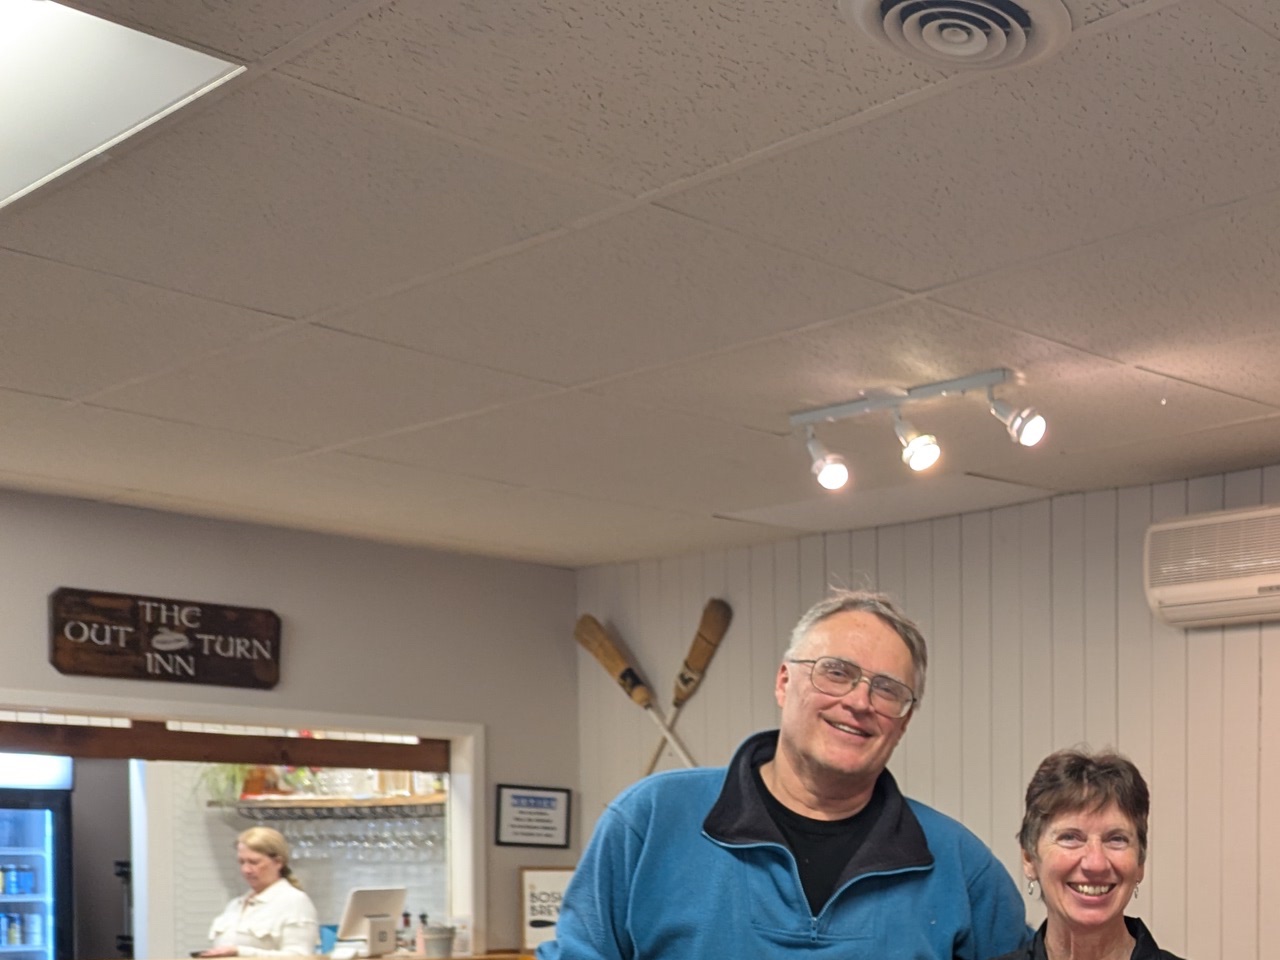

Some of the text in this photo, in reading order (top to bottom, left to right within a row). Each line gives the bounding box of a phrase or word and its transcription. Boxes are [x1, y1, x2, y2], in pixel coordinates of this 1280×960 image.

[138, 601, 201, 628] THE
[64, 620, 271, 660] OUT TURN
[145, 652, 195, 676] INN
